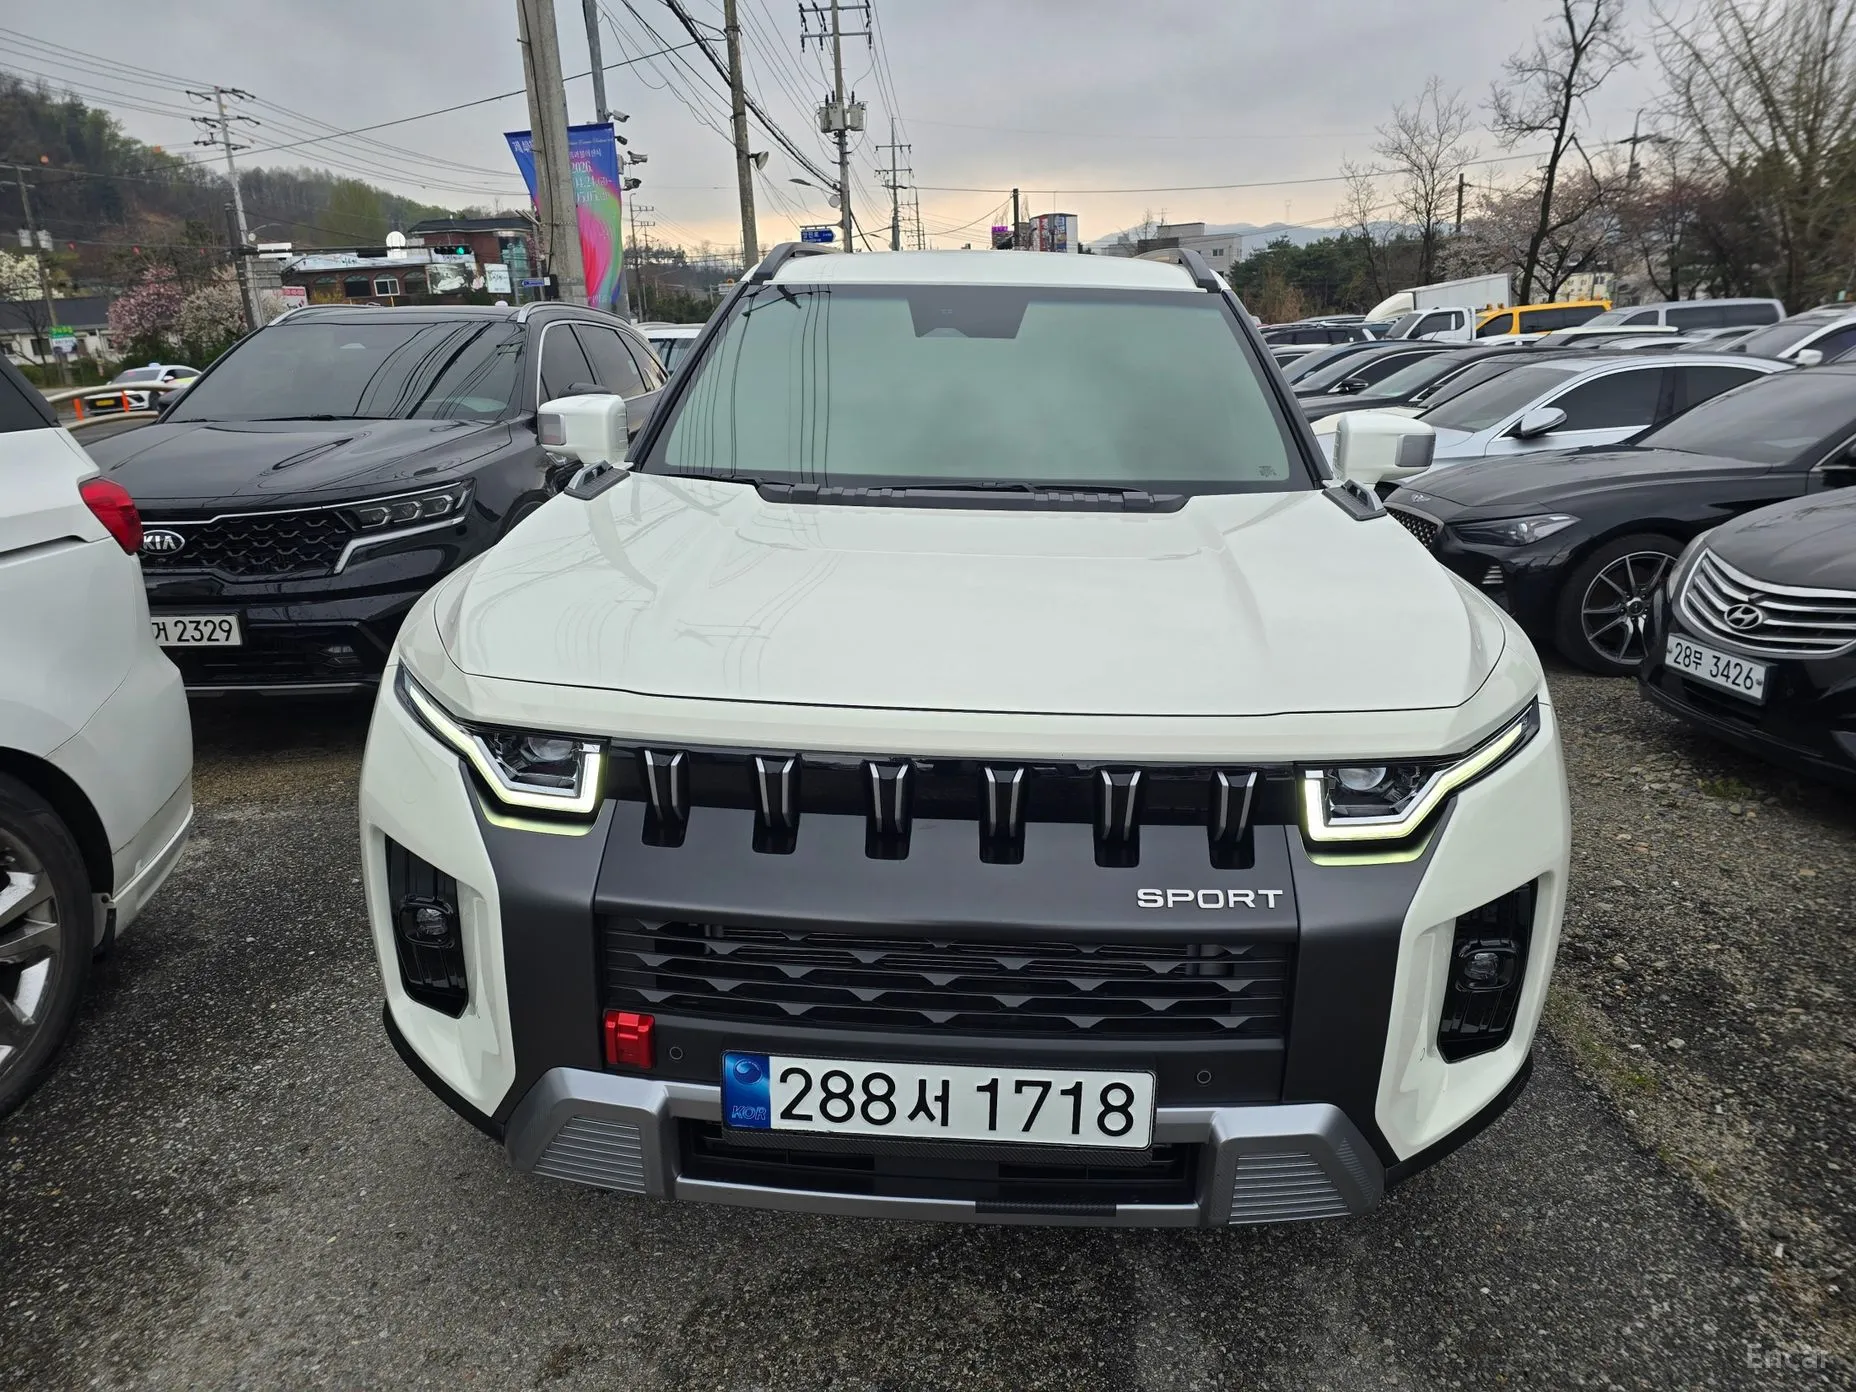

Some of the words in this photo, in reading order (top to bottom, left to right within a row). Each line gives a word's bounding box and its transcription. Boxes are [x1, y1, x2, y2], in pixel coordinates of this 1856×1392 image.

[143, 535, 176, 550] KIA
[174, 619, 233, 642] 2329
[1673, 642, 1703, 671] 28무
[1709, 654, 1754, 690] 3426
[1137, 888, 1284, 909] SPORT
[731, 1105, 767, 1121] KOR
[779, 1067, 950, 1127] 288서
[976, 1077, 1136, 1137] 1718
